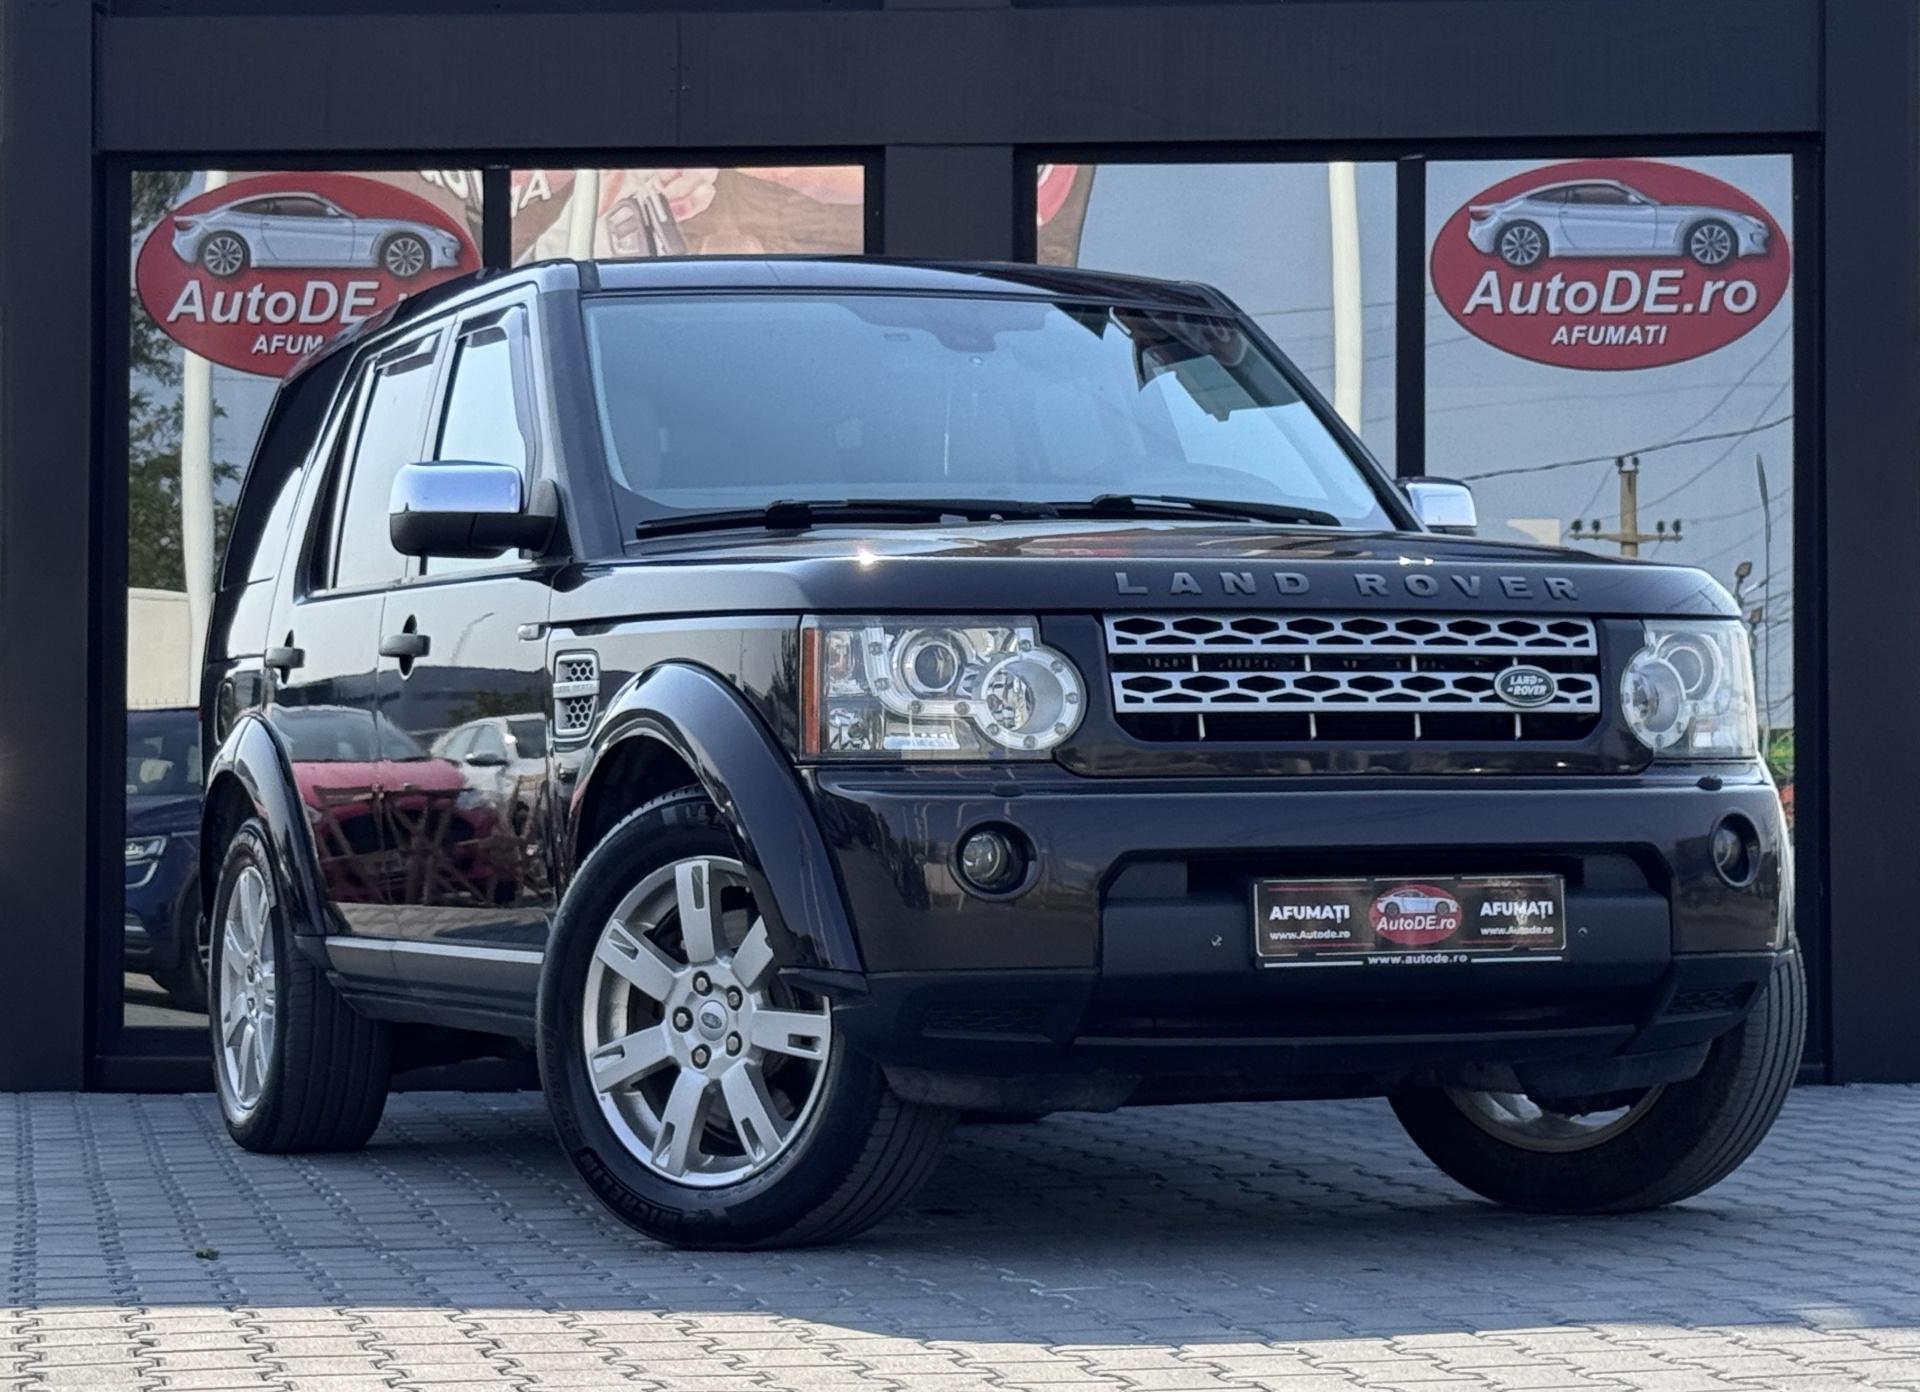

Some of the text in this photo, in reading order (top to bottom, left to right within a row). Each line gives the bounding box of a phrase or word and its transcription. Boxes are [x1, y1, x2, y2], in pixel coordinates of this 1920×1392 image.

[1462, 269, 1758, 316] AutoDE.ro
[1551, 324, 1668, 346] AFUMATI
[1115, 571, 1580, 600] LAND ROVER
[1509, 674, 1538, 685] LAND
[1512, 685, 1548, 696] ROVER
[1376, 915, 1457, 932] AutoDE.ro
[1367, 953, 1469, 966] www.autode.ro
